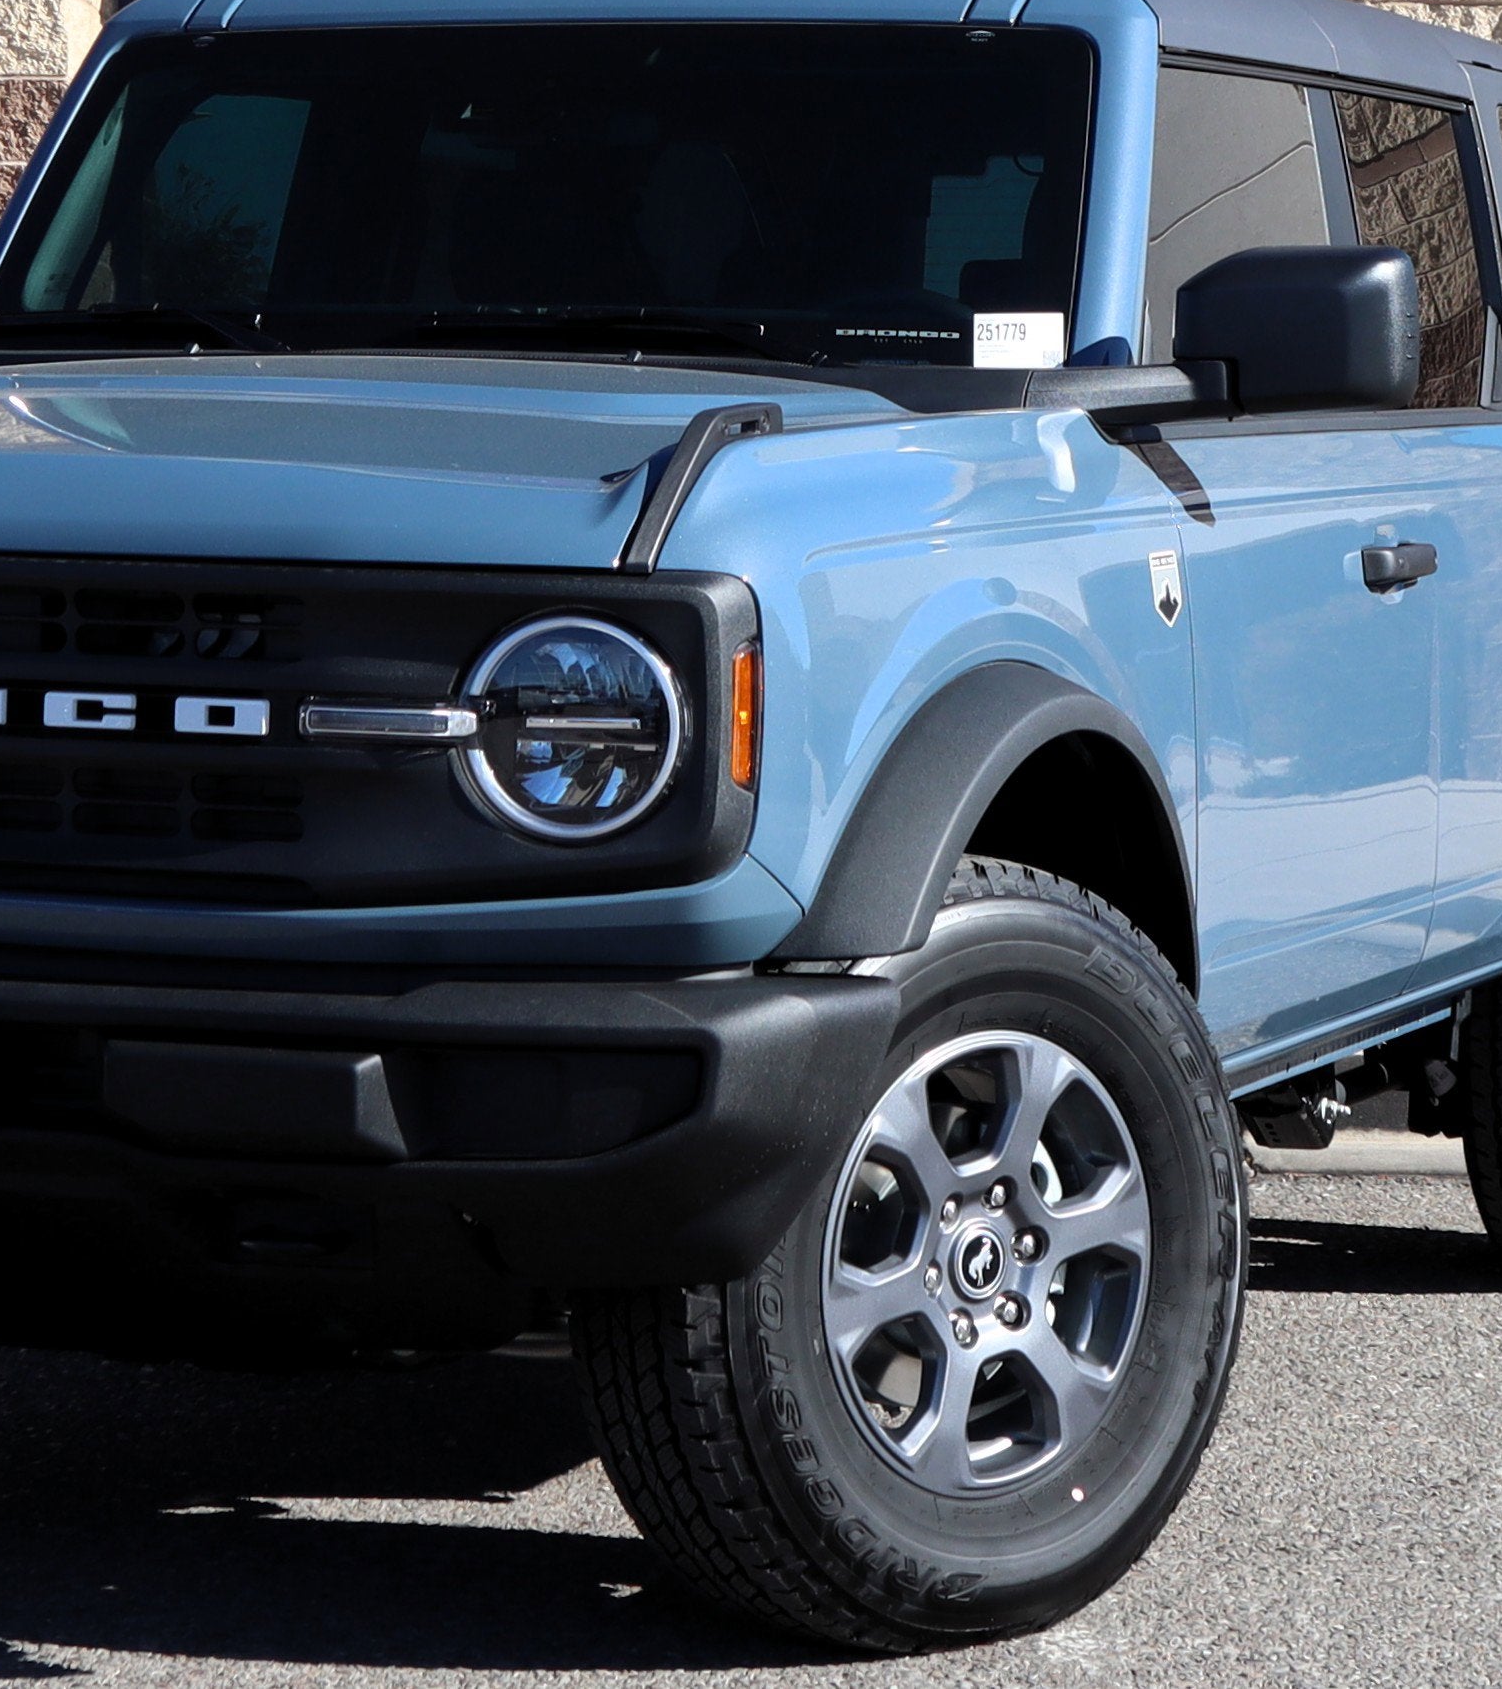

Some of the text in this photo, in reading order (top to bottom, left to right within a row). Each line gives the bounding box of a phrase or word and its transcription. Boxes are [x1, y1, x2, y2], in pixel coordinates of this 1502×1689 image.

[976, 323, 1027, 342] 251779
[1084, 944, 1239, 1282] DUELER
[754, 1232, 989, 1603] BRIDGESTO
